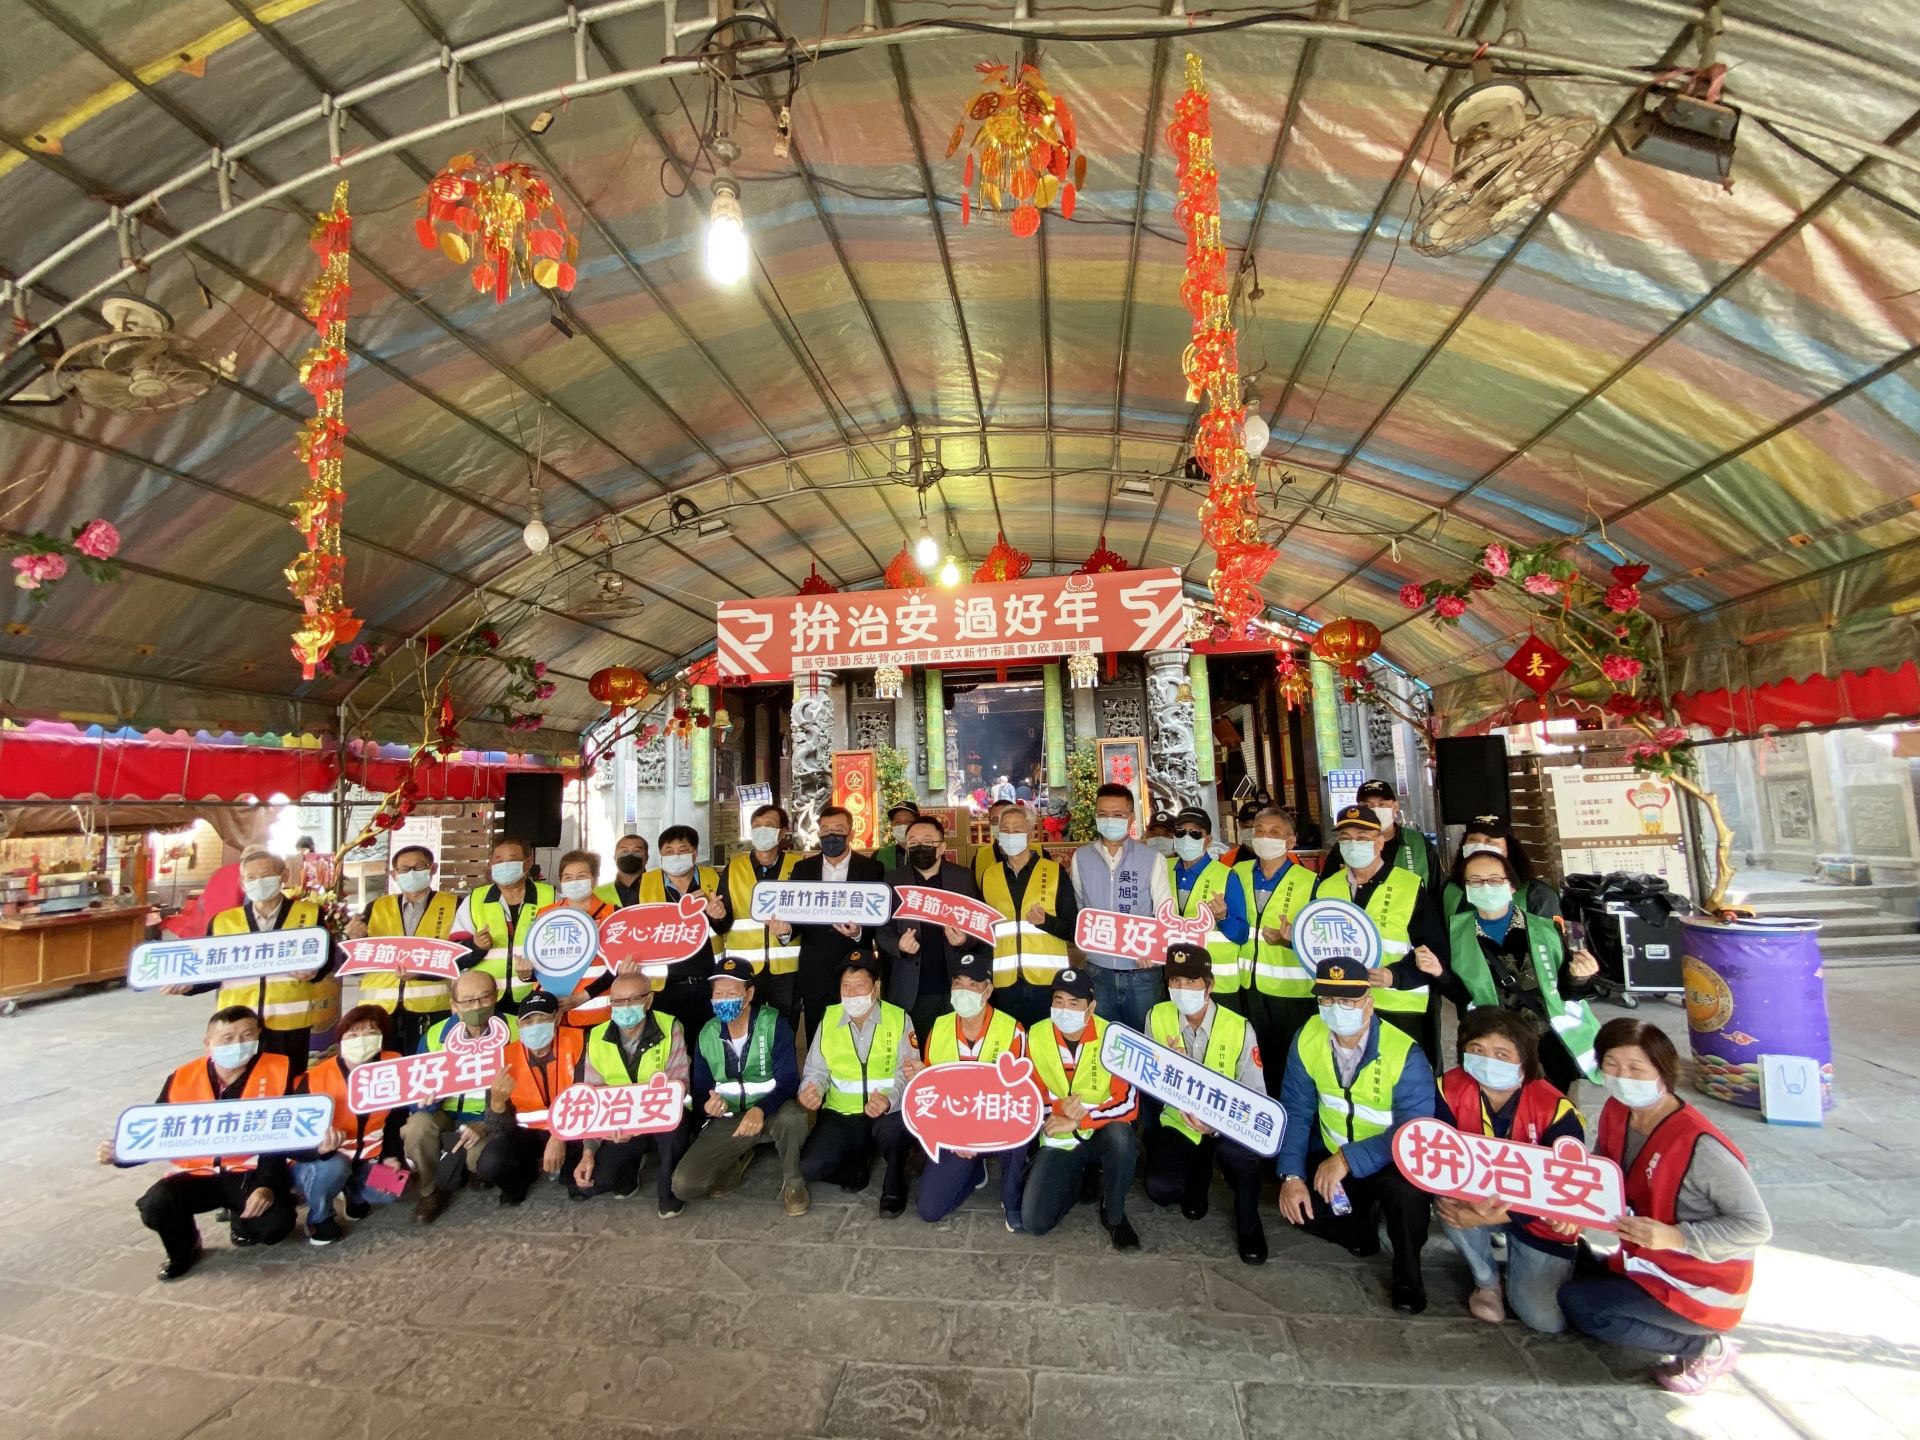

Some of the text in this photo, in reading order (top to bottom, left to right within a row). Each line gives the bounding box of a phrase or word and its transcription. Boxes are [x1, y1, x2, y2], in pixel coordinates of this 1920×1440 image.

[954, 590, 1100, 641] 過好年
[778, 908, 863, 917] HSINCHU CITY COUNCIL
[779, 889, 865, 909] 新竹市議會
[905, 889, 990, 934] 春節 守護
[604, 921, 701, 946] 愛心相挺
[205, 937, 320, 966] 新竹市議會
[205, 955, 319, 975] HSINCHU CITY COUNCIL
[353, 942, 452, 970] 春節 守護
[1312, 946, 1362, 957] 新竹市議會
[358, 1048, 496, 1108] 過好年
[914, 1085, 1032, 1125] 愛心相挺
[1162, 1064, 1275, 1138] 新竹市議會
[162, 1108, 293, 1138] 新竹市議會
[1160, 1084, 1270, 1148] HSINCHU CITY COUNCIL
[159, 1131, 290, 1149] HSINCHU CITY COUNCIL
